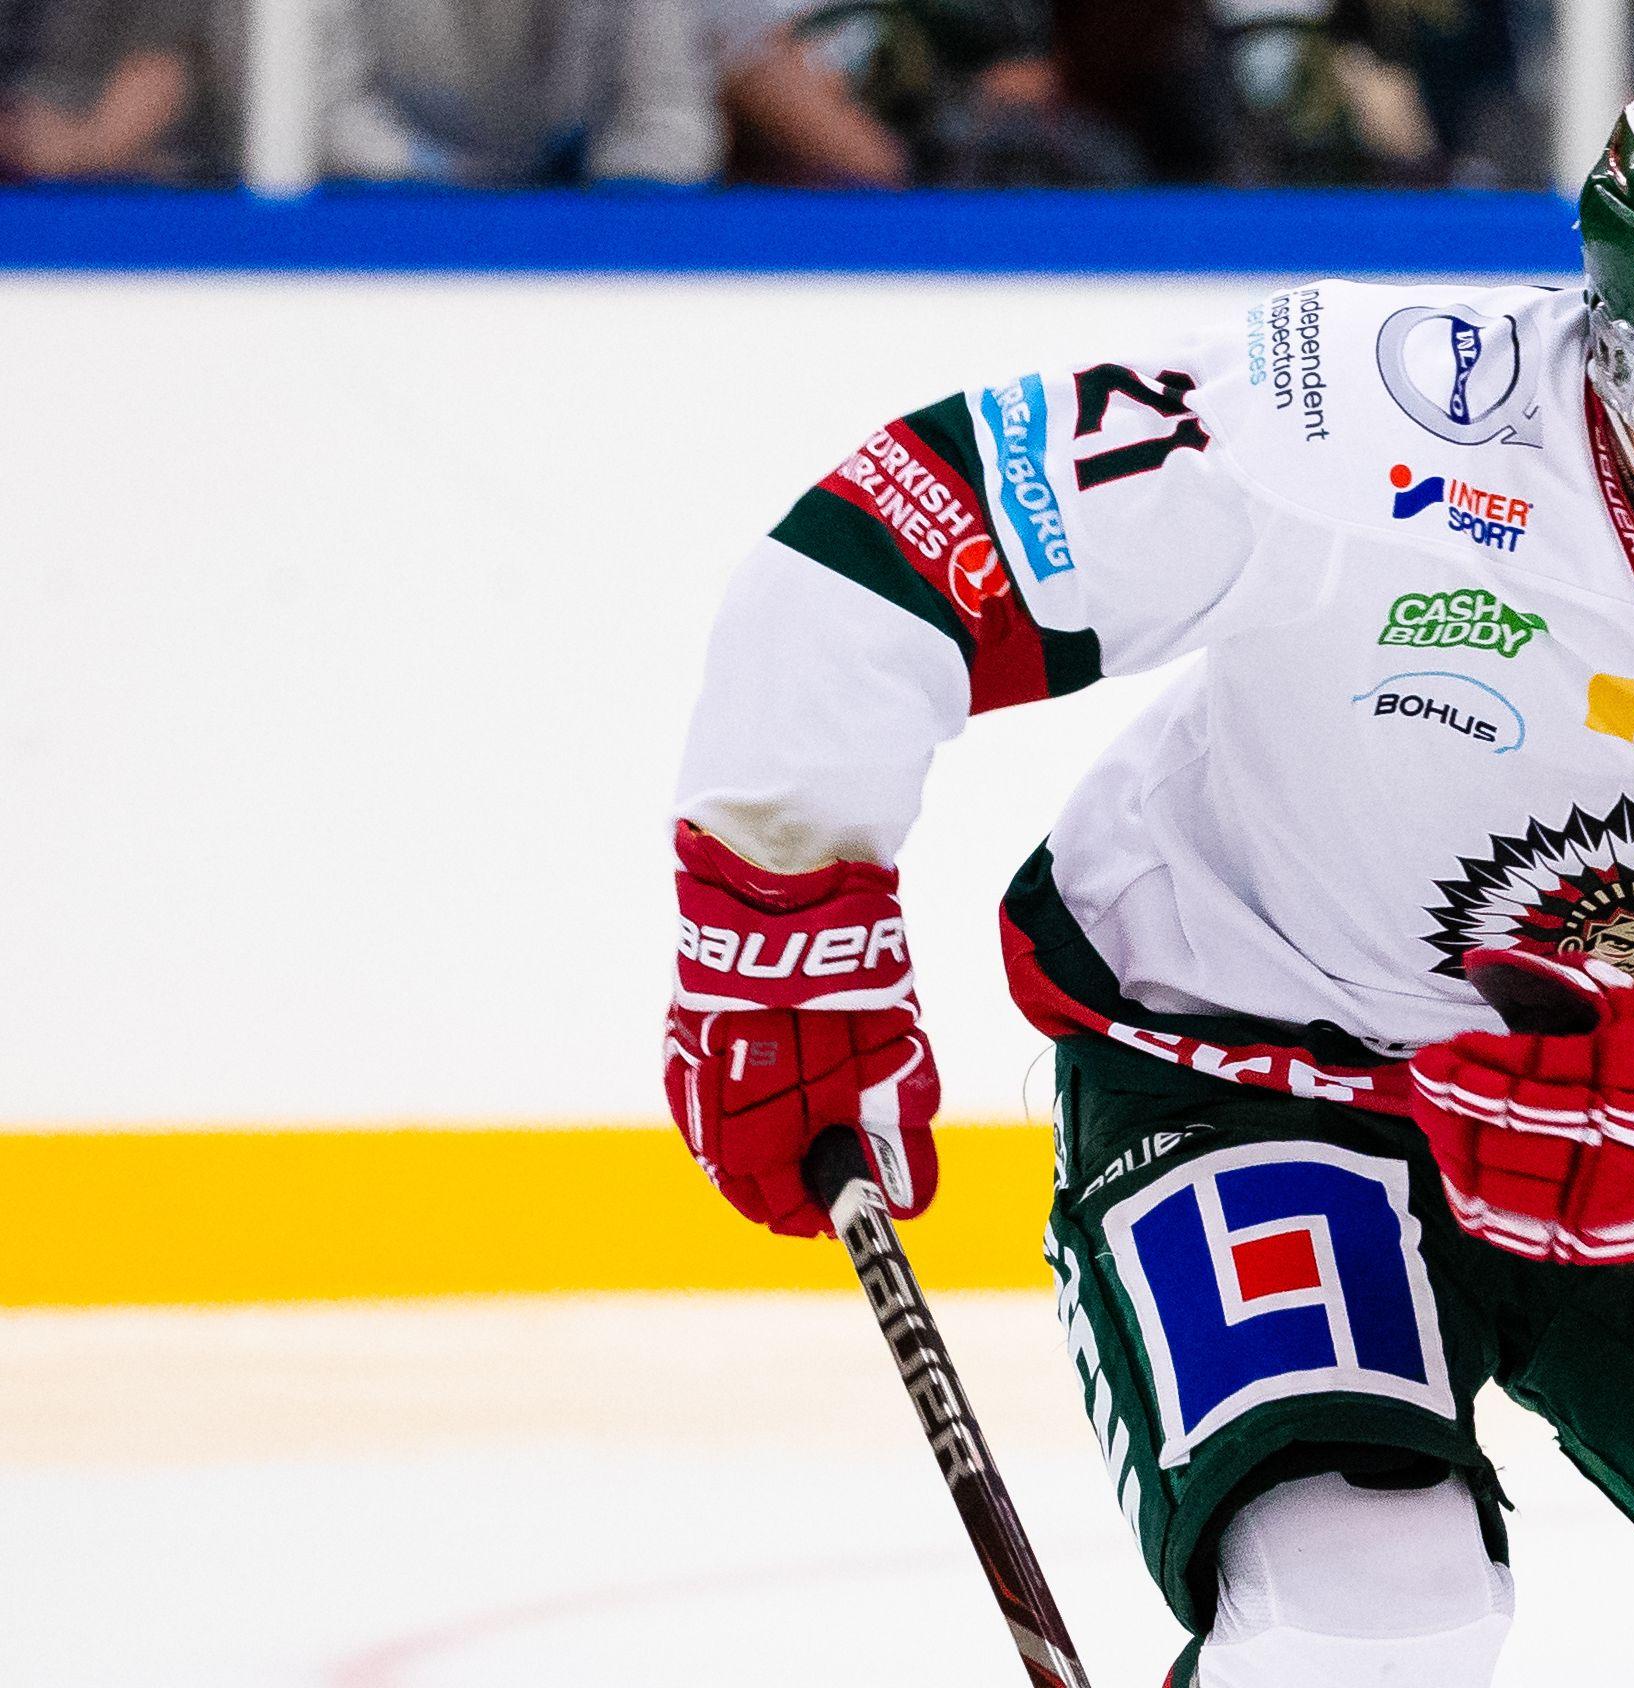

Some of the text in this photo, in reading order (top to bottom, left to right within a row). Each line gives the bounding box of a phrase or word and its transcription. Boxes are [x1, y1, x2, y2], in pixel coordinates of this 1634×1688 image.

[1247, 301, 1268, 387] ervices
[1270, 290, 1295, 411] inspection
[1297, 288, 1330, 442] independent
[1073, 363, 1210, 492] 21
[837, 451, 949, 561] RLINES
[863, 428, 976, 538] URKISH
[1449, 478, 1530, 528] INTER
[1447, 507, 1526, 553] SPORT
[1382, 618, 1533, 656] BUDDY
[1393, 588, 1500, 625] CASH
[1373, 692, 1498, 744] BOHUS
[676, 914, 908, 979] BAUER
[842, 1205, 986, 1492] BAUER
